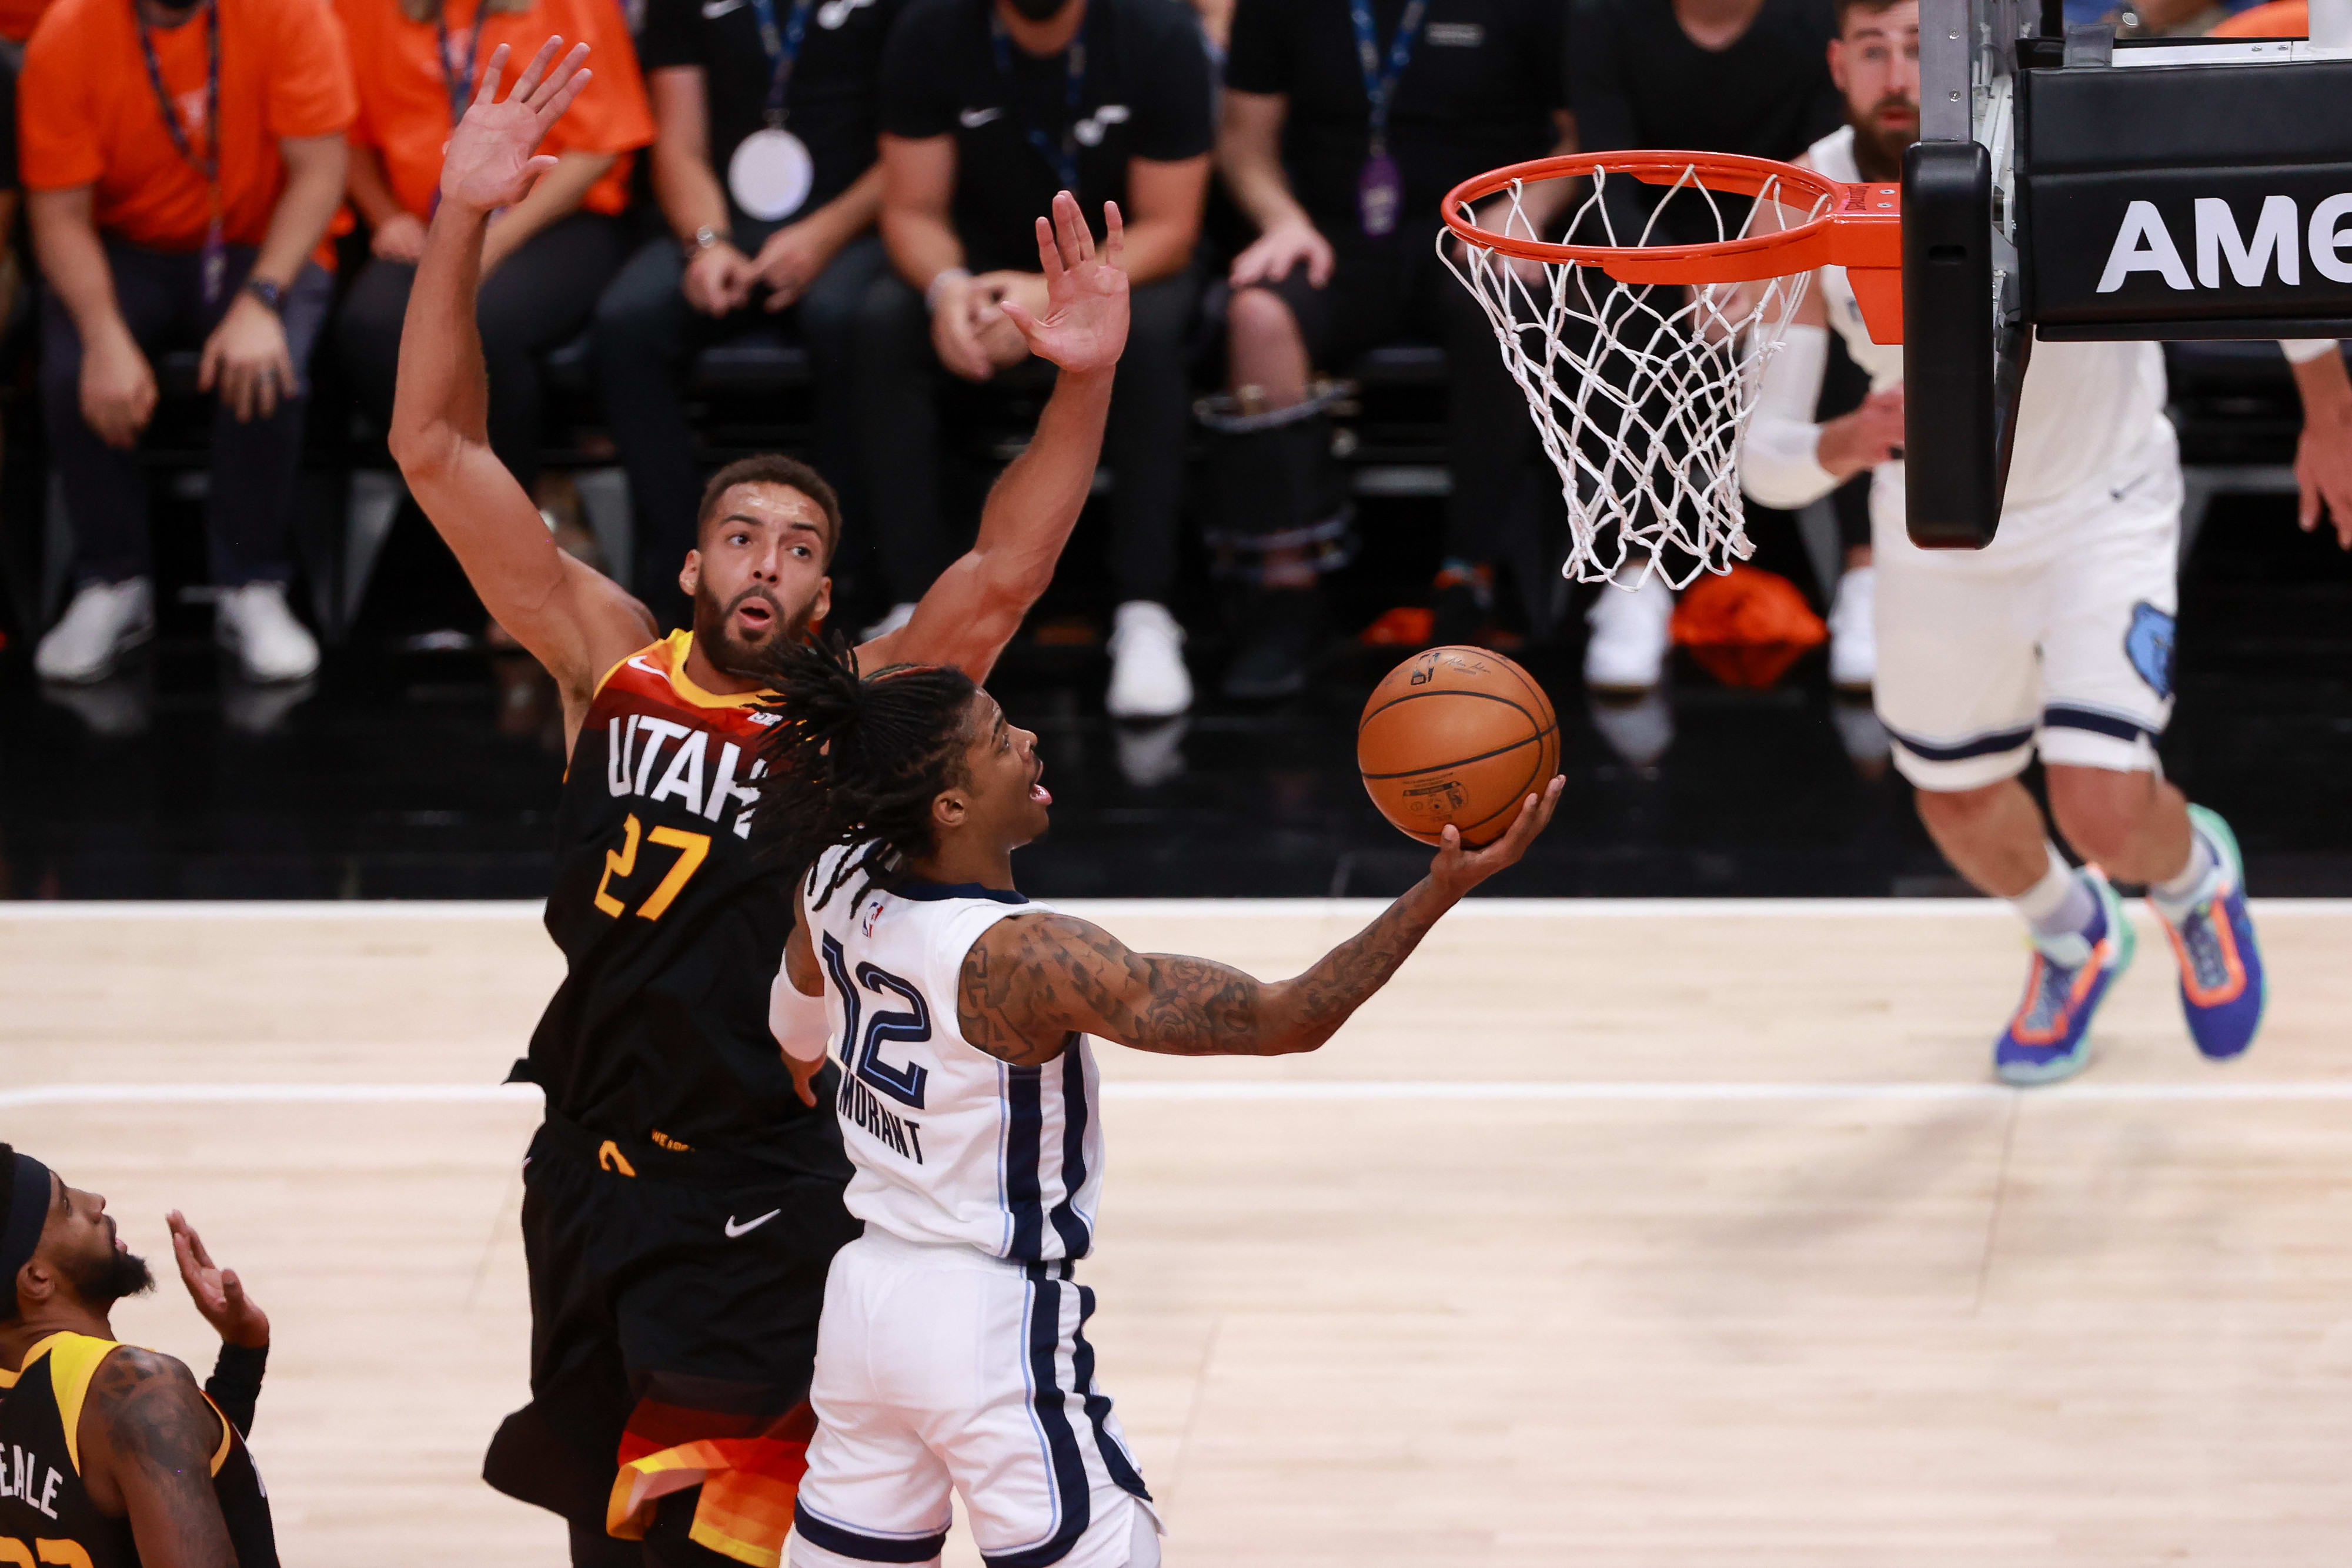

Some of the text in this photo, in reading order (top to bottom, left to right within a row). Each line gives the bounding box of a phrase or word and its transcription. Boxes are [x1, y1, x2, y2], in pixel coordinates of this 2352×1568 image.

[608, 714, 769, 840] UTAH
[594, 813, 712, 921] 27
[822, 929, 931, 1109] 12
[836, 1069, 923, 1165] MORANT
